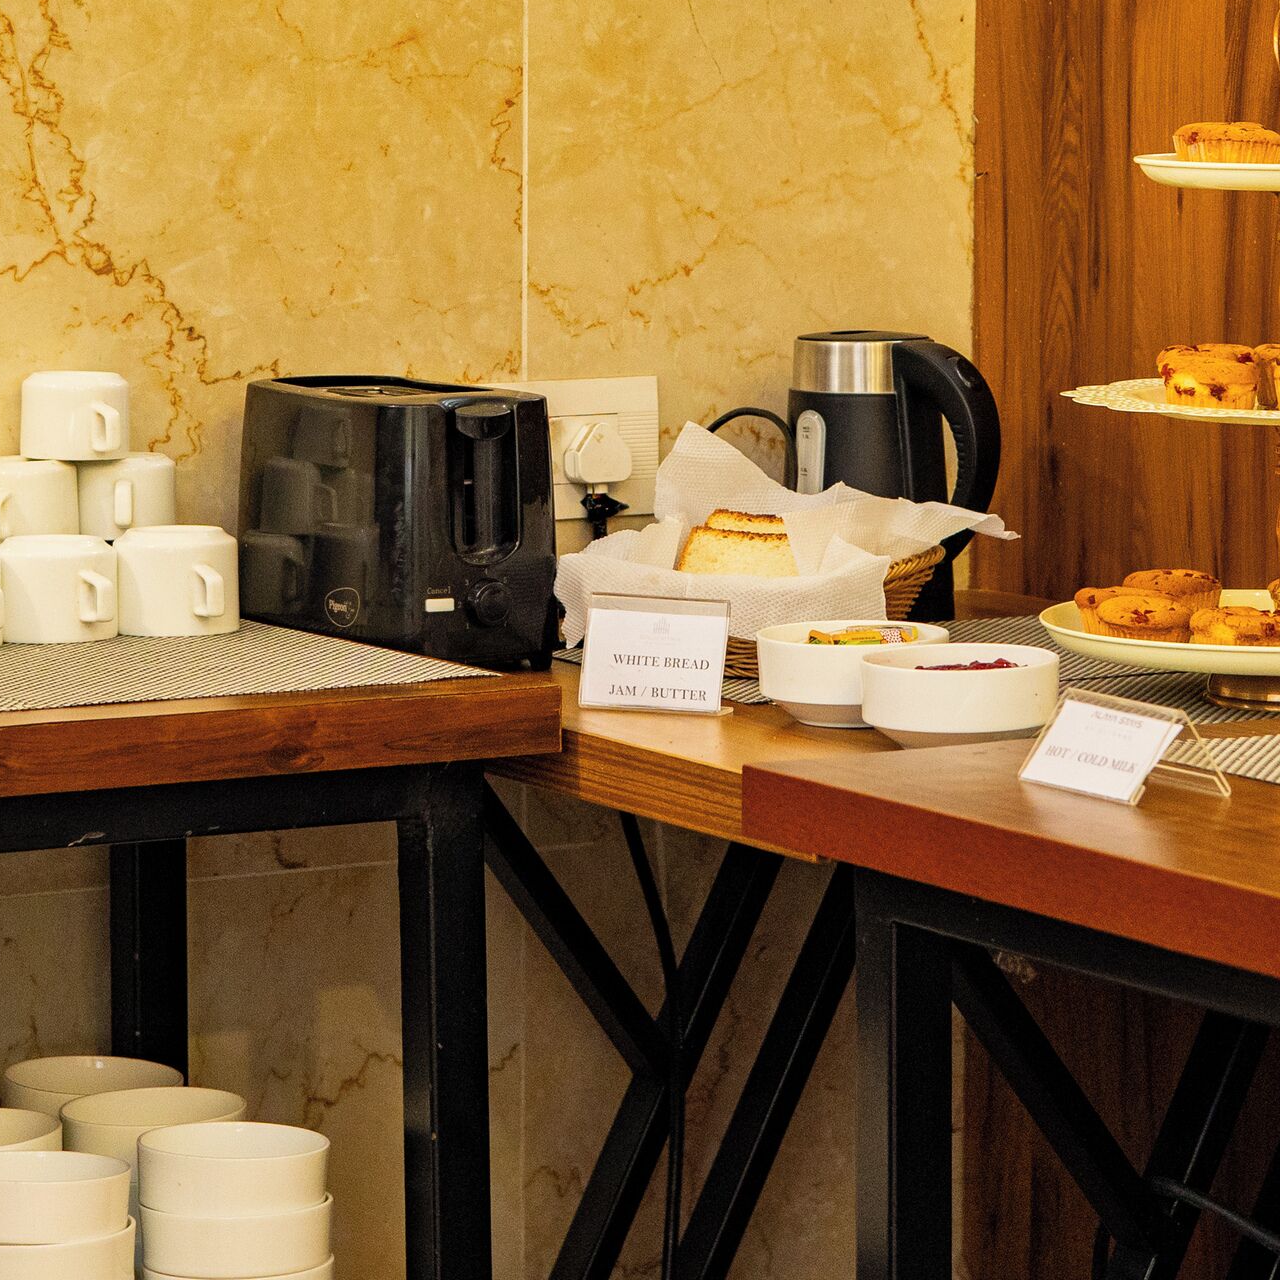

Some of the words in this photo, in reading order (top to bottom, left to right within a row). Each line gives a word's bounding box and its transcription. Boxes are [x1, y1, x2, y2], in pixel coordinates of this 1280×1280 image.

[426, 586, 452, 595] Cancel
[613, 653, 660, 668] WHITE
[663, 656, 710, 671] BREAD
[608, 684, 636, 697] JAM
[640, 686, 647, 697] /
[651, 687, 707, 701] BUTTER
[1045, 744, 1071, 758] HOT
[1077, 751, 1109, 768] COLD
[1110, 759, 1139, 774] MILK
